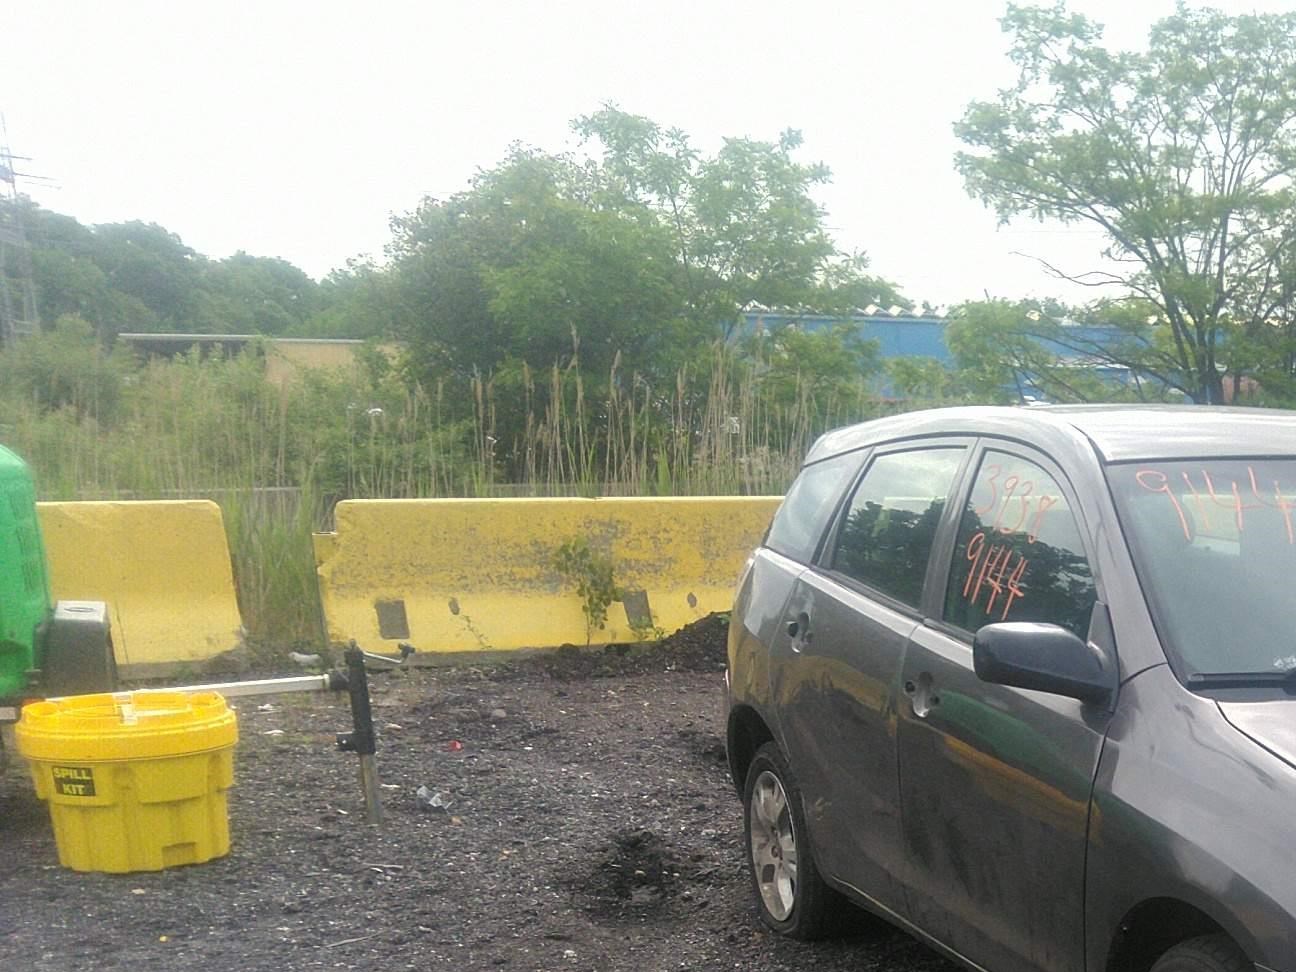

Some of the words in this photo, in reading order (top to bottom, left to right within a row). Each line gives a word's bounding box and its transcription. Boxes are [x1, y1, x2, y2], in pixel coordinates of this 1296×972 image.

[975, 464, 1057, 544] 3938
[963, 533, 1029, 621] 9144
[53, 767, 92, 780] SPILL
[62, 783, 85, 795] KIT
